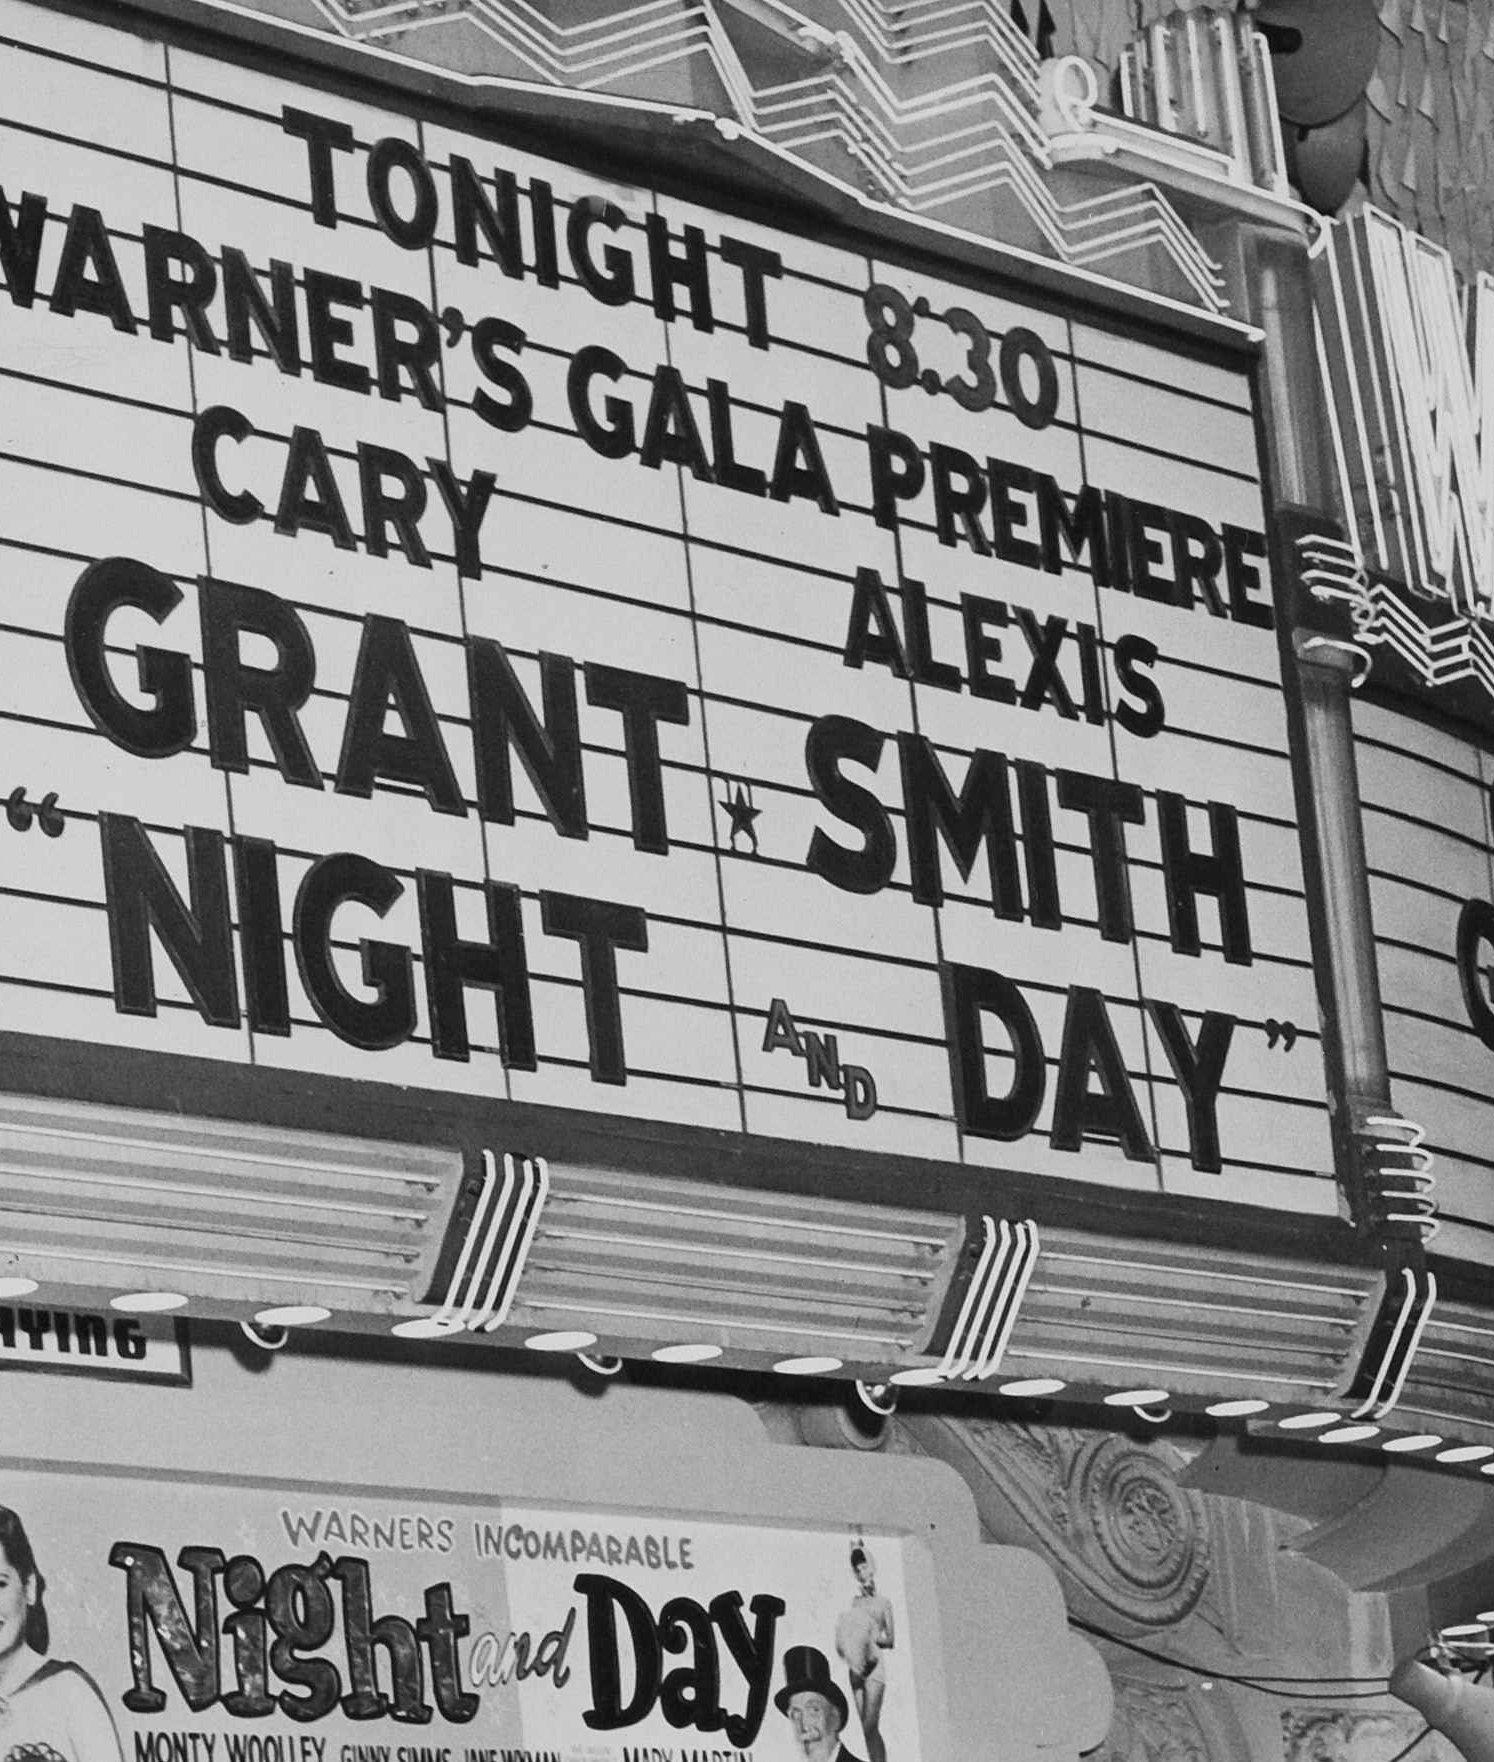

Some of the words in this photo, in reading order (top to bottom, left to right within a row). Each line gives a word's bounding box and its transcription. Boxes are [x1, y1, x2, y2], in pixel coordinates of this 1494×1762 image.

[282, 105, 783, 350] TONIGHT
[864, 284, 1060, 430] 8:30
[191, 407, 497, 581] CARY
[566, 346, 840, 517] GALA
[866, 423, 1275, 628] PREMIERE
[65, 556, 691, 855] GRANT
[844, 567, 1167, 739] ALEXIS
[805, 715, 1254, 968] SMITH
[762, 999, 878, 1122] AND
[280, 1508, 455, 1554] WARNERS
[473, 1521, 696, 1570] INCOMPARABLE
[109, 1541, 481, 1724] Night
[469, 1606, 578, 1689] and
[573, 1572, 787, 1749] Day
